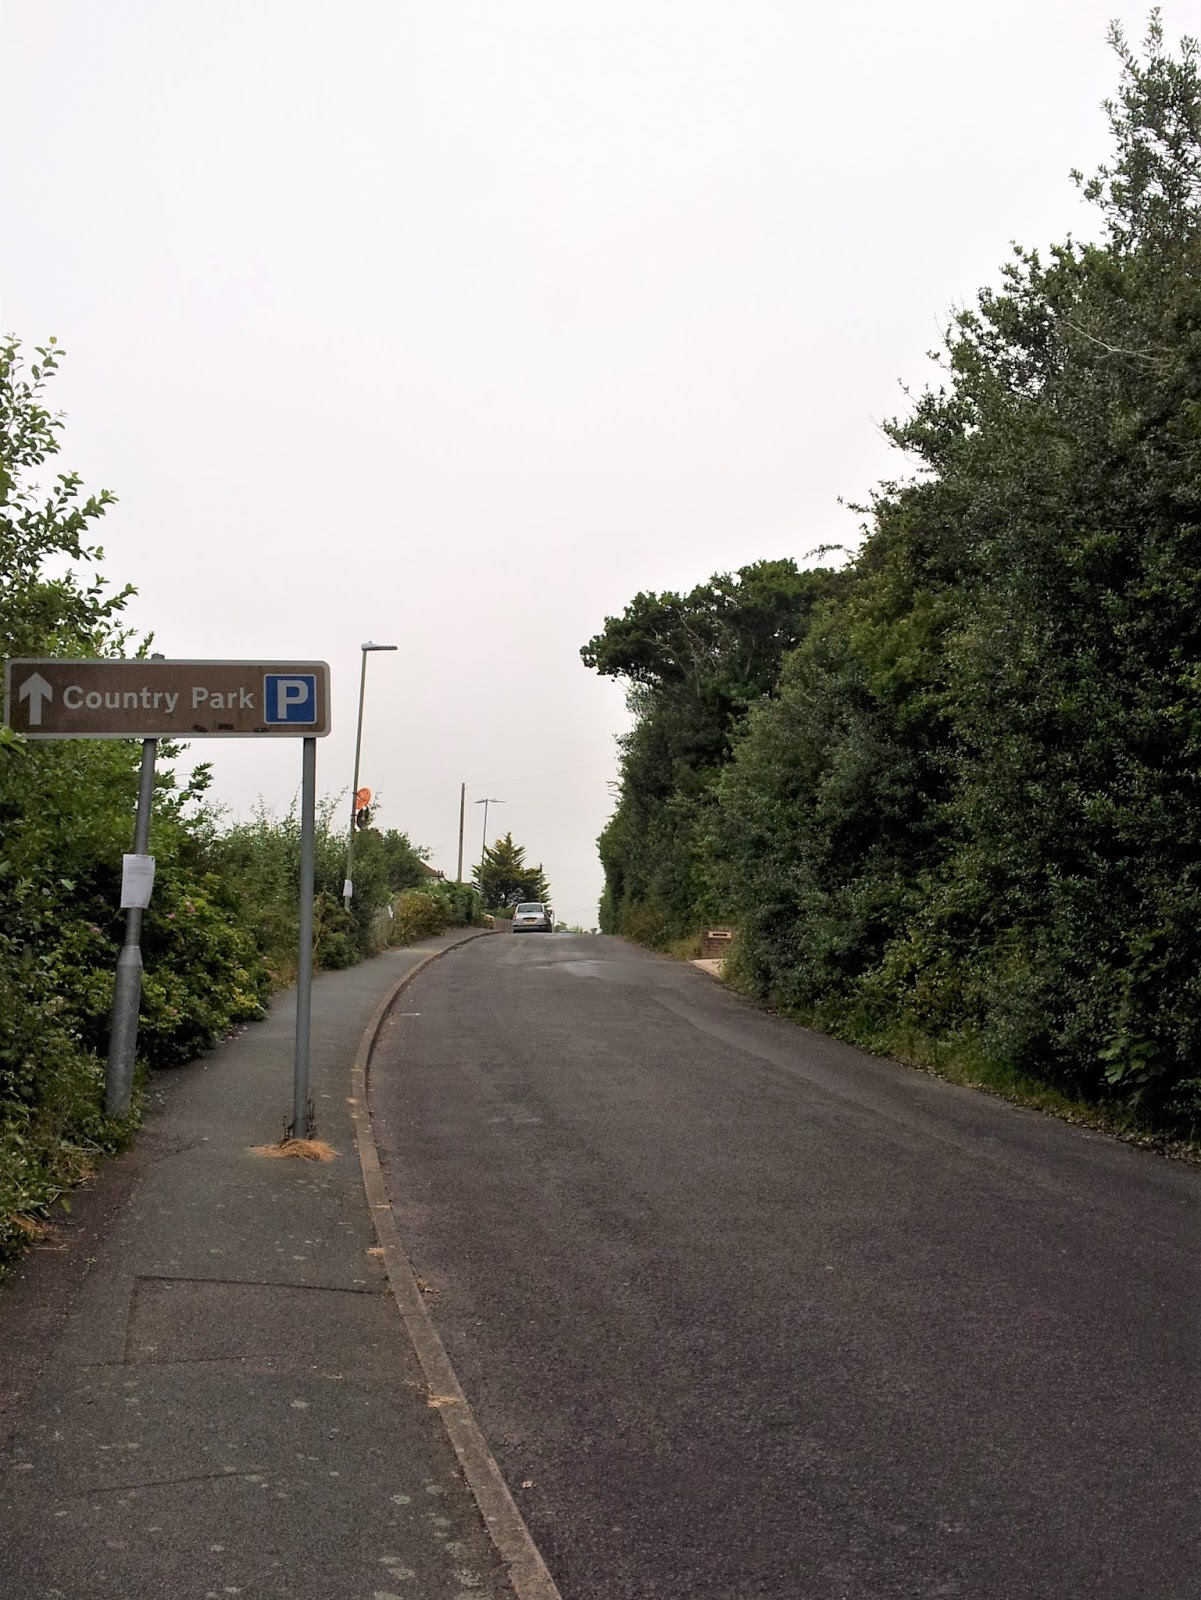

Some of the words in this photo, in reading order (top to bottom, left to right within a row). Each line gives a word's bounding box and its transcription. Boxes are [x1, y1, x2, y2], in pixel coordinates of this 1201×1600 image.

[62, 685, 179, 714] Country
[191, 686, 255, 710] Park
[276, 679, 309, 719] P
